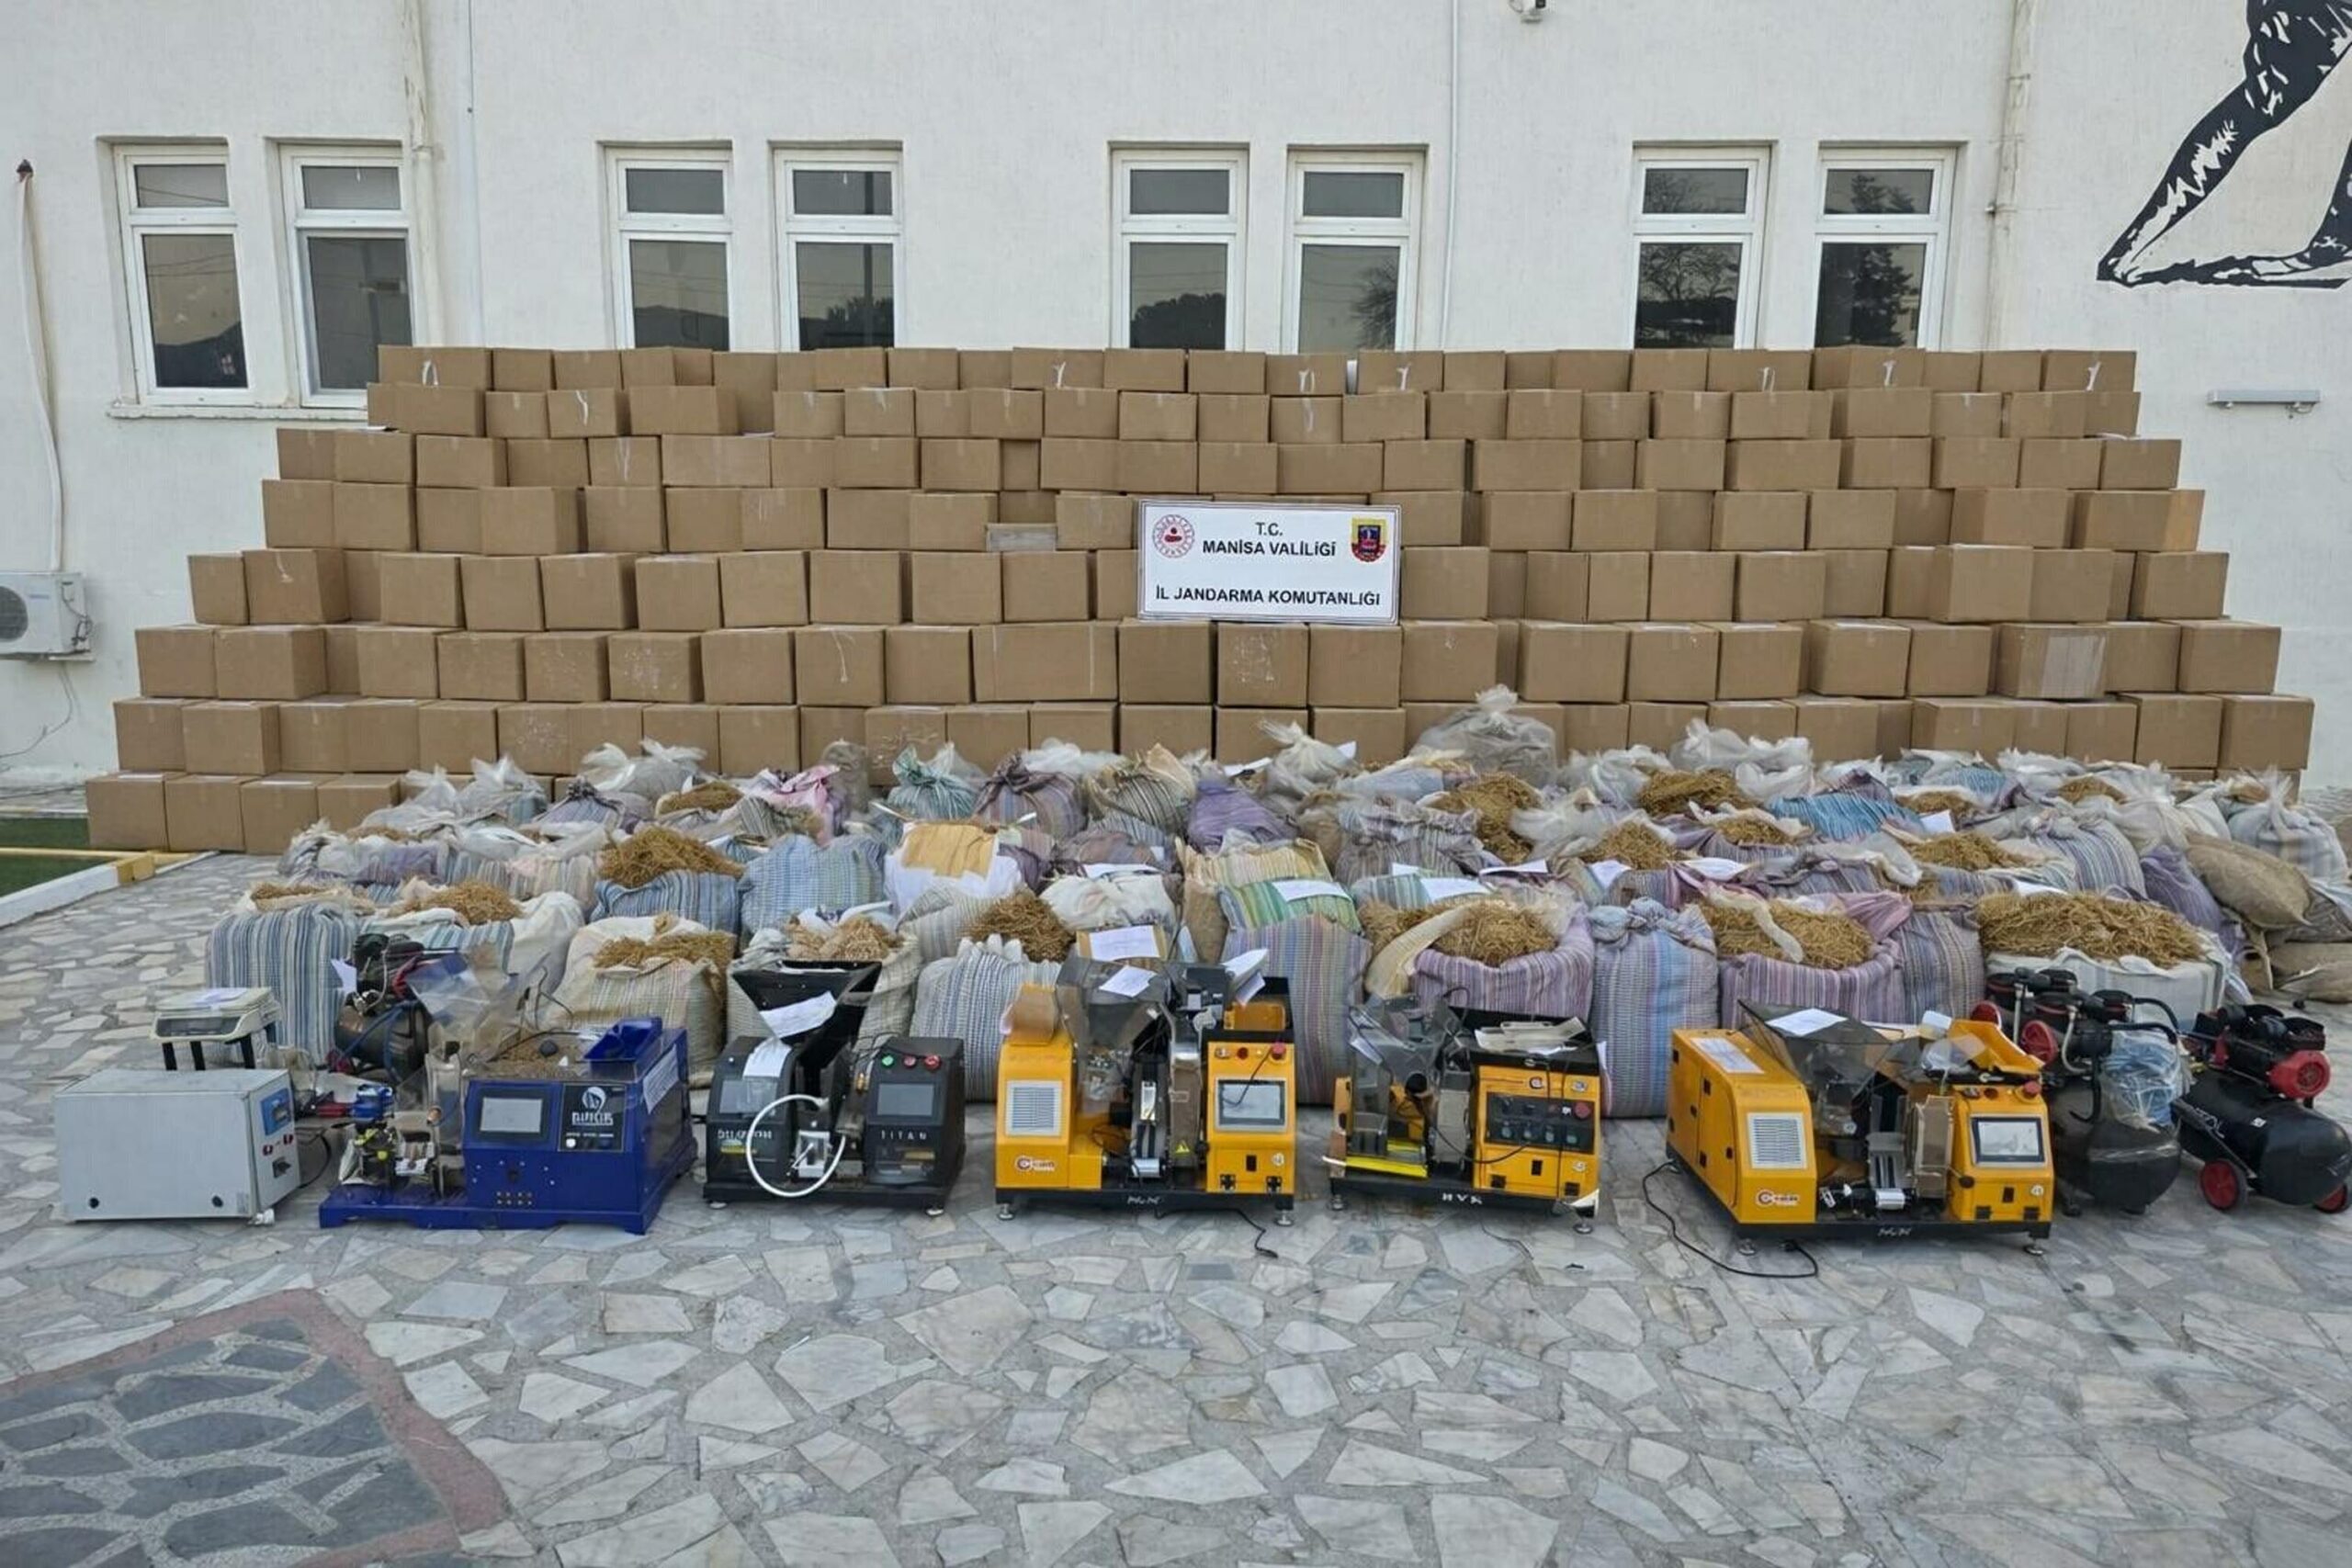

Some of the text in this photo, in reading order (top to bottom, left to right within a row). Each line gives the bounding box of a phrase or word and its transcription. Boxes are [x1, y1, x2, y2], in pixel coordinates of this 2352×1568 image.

[1255, 522, 1283, 536] T.C.
[1203, 539, 1336, 557] MANİSA VALİLİĞİ
[1156, 585, 1380, 606] İL JANDARMA KOMUTANLIĞI
